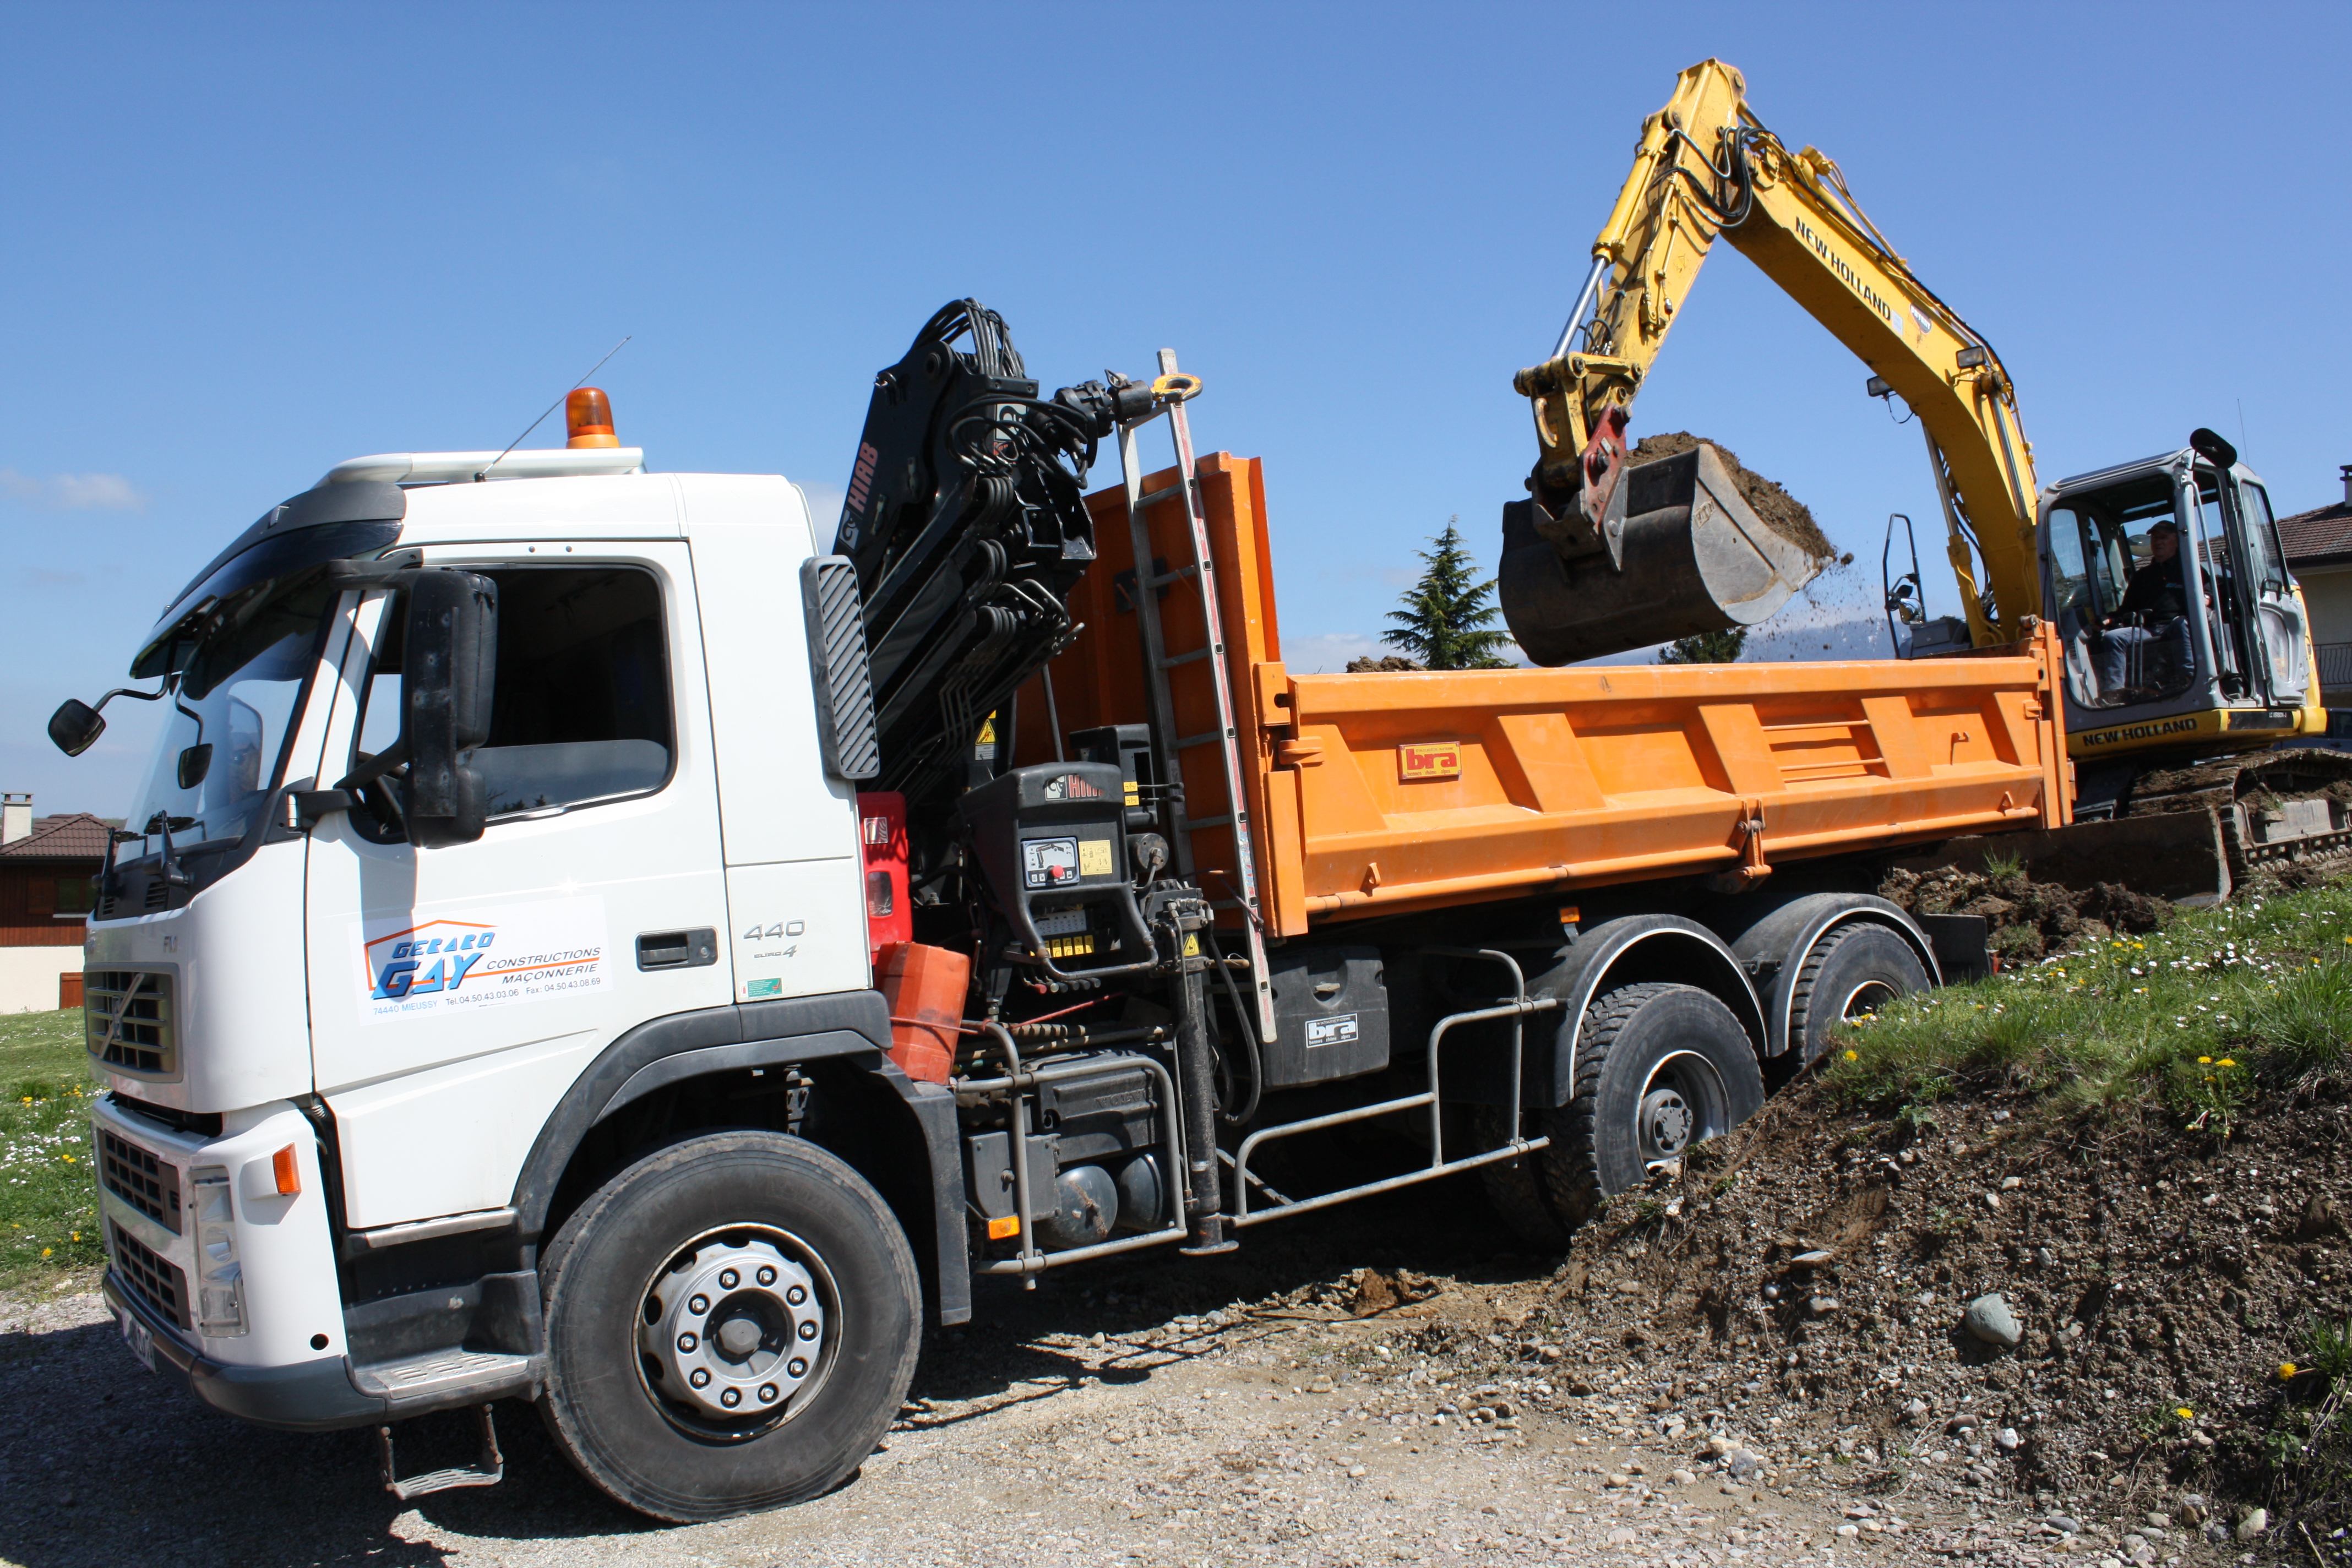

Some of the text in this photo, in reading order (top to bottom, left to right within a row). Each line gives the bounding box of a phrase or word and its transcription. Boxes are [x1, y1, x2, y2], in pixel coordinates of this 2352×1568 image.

[1795, 216, 1891, 322] NEW HOLLAND
[847, 441, 878, 514] HIAB
[2083, 718, 2198, 747] NEW HOLLAND
[1406, 748, 1457, 770] bra
[743, 918, 805, 940] 440
[486, 947, 601, 970] CONSTRUCTIONS
[371, 952, 485, 1000] GAY
[502, 963, 598, 984] MAÇONNERIE
[373, 1005, 400, 1015] 74440
[402, 1000, 438, 1011] MIEUSSY
[544, 977, 601, 992] 04.50.43.08.69
[1308, 1020, 1356, 1040] bra
